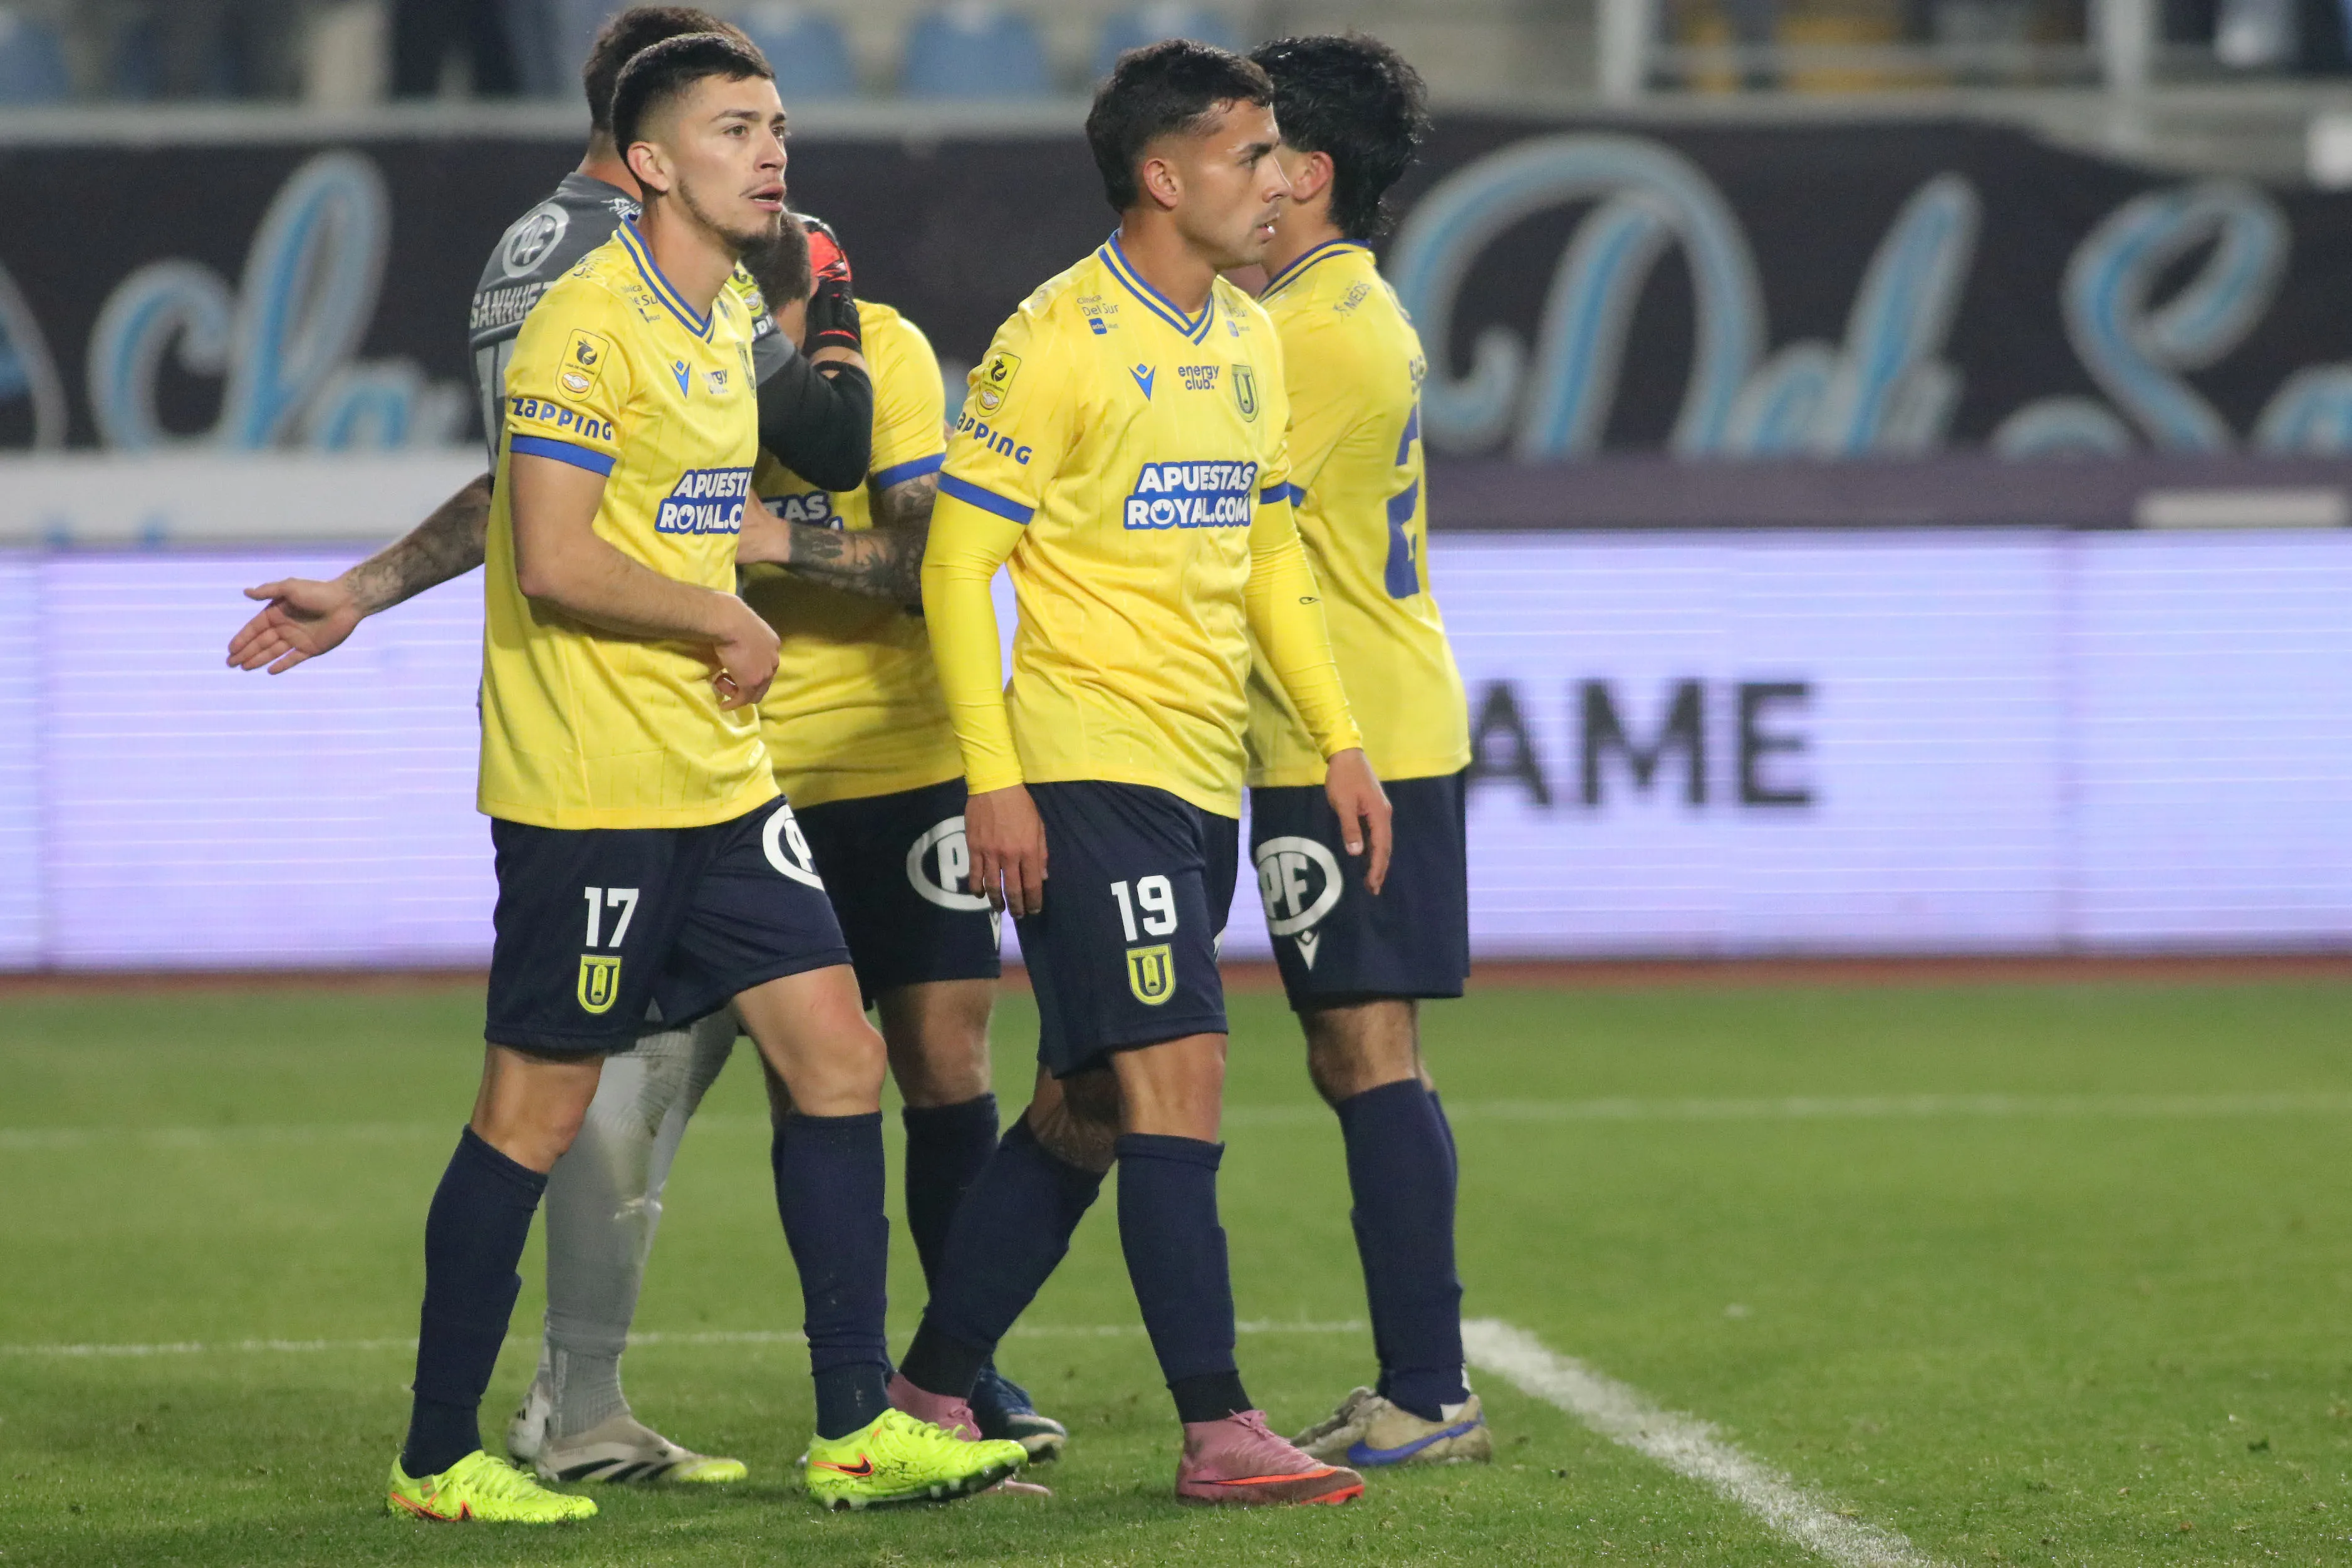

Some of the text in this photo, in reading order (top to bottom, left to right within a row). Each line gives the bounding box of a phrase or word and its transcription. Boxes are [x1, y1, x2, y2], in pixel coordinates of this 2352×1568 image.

[471, 281, 556, 329] SANHUE
[1082, 303, 1119, 316] Del Sur
[1178, 366, 1219, 380] energy
[1185, 378, 1214, 390] club.
[956, 412, 1033, 465] apping
[674, 471, 752, 498] APUEST
[1138, 465, 1255, 492] APUESTAS
[660, 503, 744, 530] ROYAL.C
[1128, 496, 1249, 525] ROYAL.COM
[1257, 851, 1308, 919] PF
[584, 886, 639, 948] 17
[1110, 875, 1178, 942] 19
